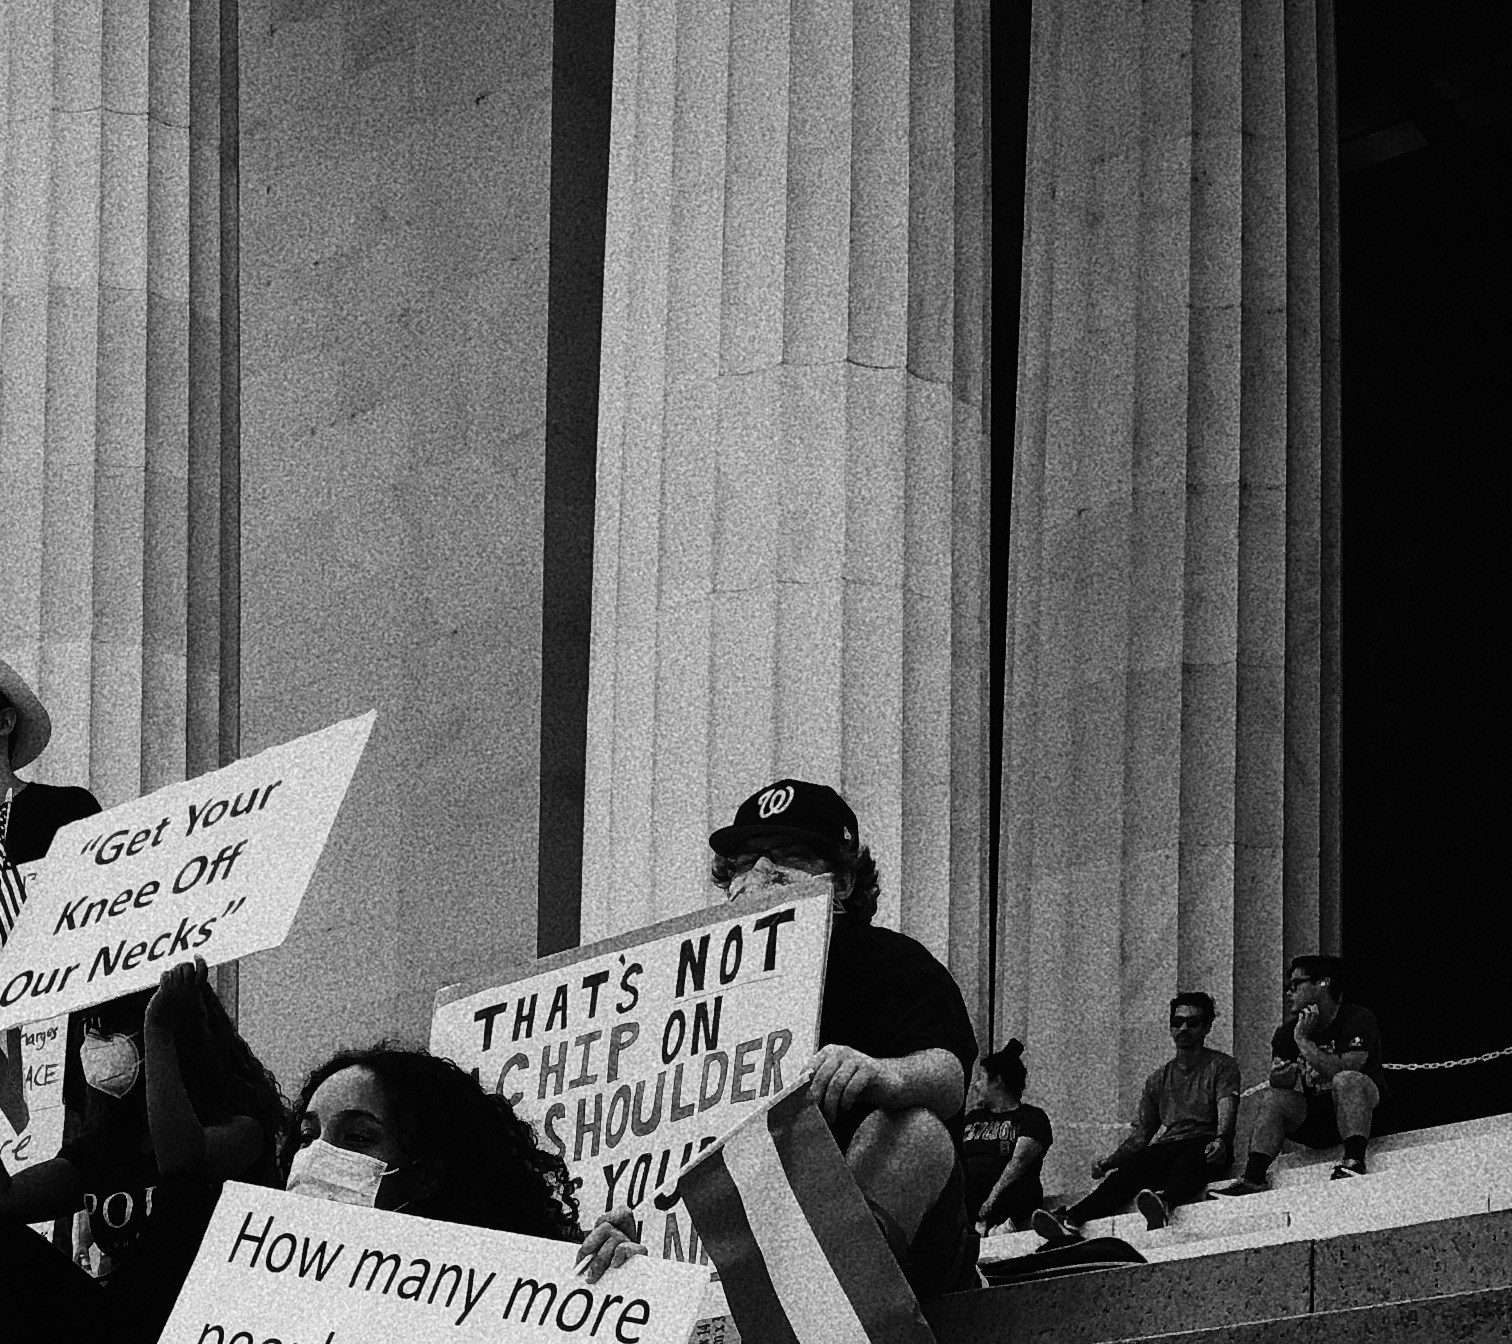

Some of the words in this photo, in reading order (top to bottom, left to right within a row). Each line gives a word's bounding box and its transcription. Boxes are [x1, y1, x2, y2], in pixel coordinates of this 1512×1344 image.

[186, 780, 283, 837] Your
[52, 880, 159, 936] Knee
[172, 839, 249, 895] Off
[0, 962, 81, 1007] Our
[474, 955, 643, 1052] THAT'S
[676, 908, 796, 999] NOT
[496, 1021, 640, 1107] CHIP
[661, 995, 724, 1064] ON
[544, 1029, 793, 1162] SHOULDER
[227, 1211, 344, 1283] How
[349, 1248, 497, 1326] many
[503, 1275, 652, 1344] more
